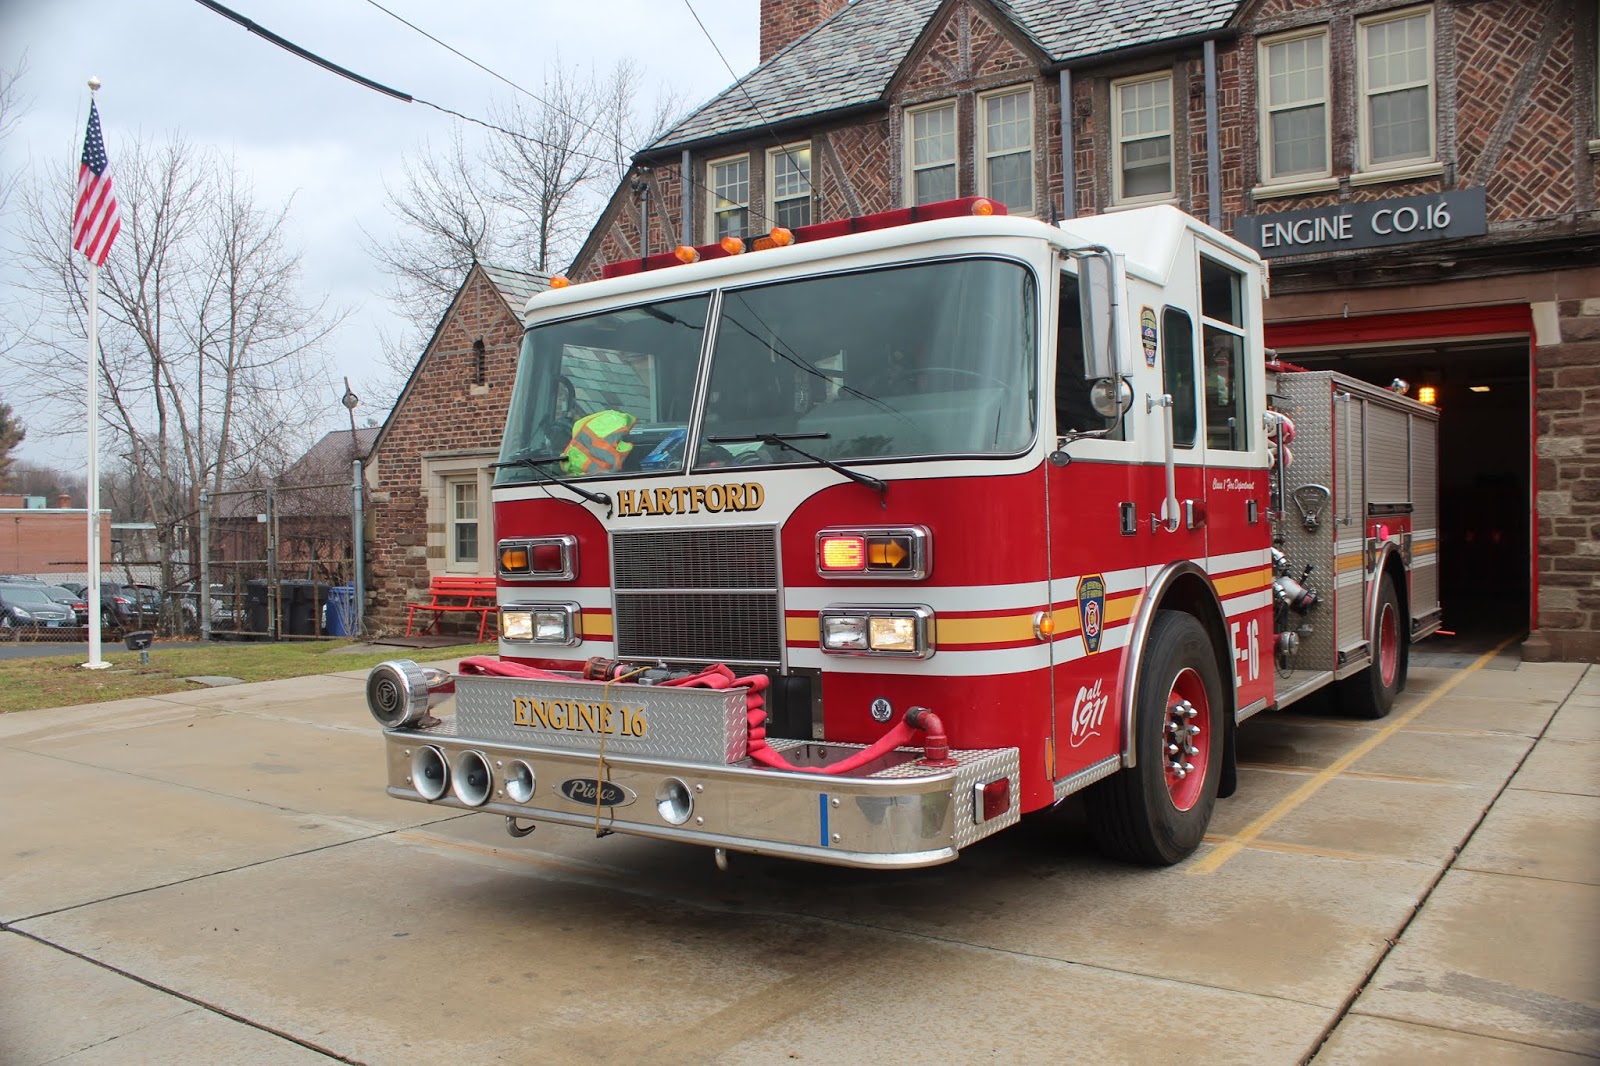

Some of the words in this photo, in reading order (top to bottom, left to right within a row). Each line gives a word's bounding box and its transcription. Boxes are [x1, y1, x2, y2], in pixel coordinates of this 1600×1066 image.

[1261, 214, 1353, 248] ENGINE
[617, 482, 765, 517] HARTFORD
[1230, 618, 1260, 688] E-16
[513, 697, 616, 734] ENGINE
[620, 705, 647, 738] 16
[1079, 695, 1108, 736] 911
